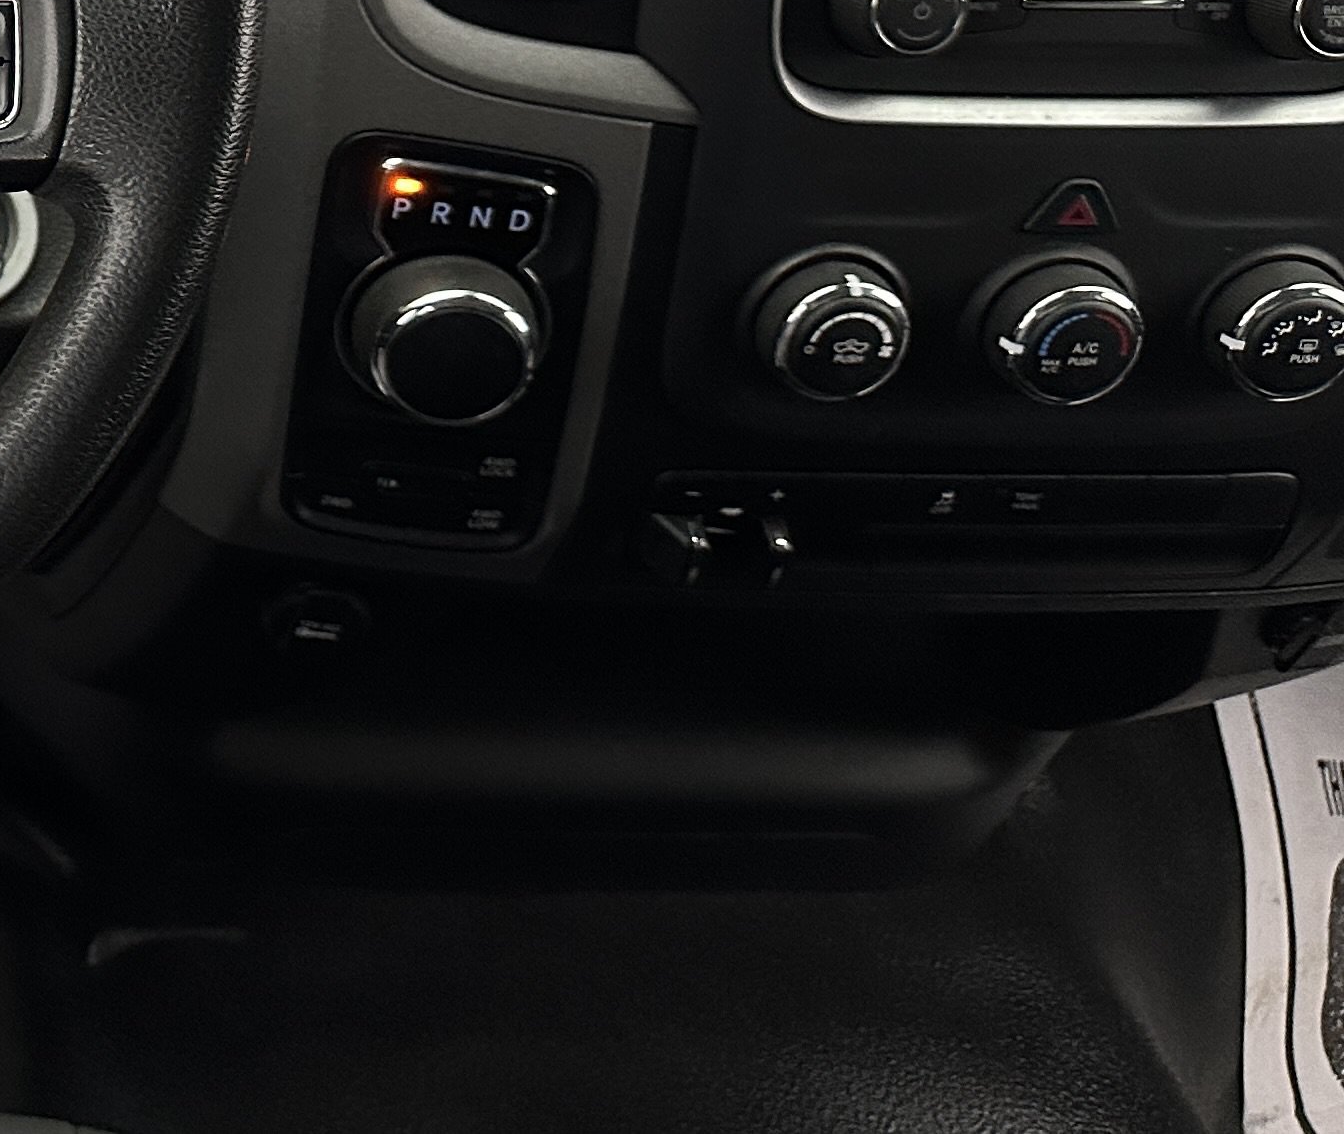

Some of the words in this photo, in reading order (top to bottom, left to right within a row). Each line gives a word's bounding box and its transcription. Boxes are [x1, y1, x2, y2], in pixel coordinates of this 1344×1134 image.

[392, 197, 412, 220] P
[430, 201, 452, 225] R
[469, 205, 493, 230] N
[509, 209, 531, 232] D
[1071, 341, 1100, 354] A/C
[1288, 353, 1322, 364] PUSH
